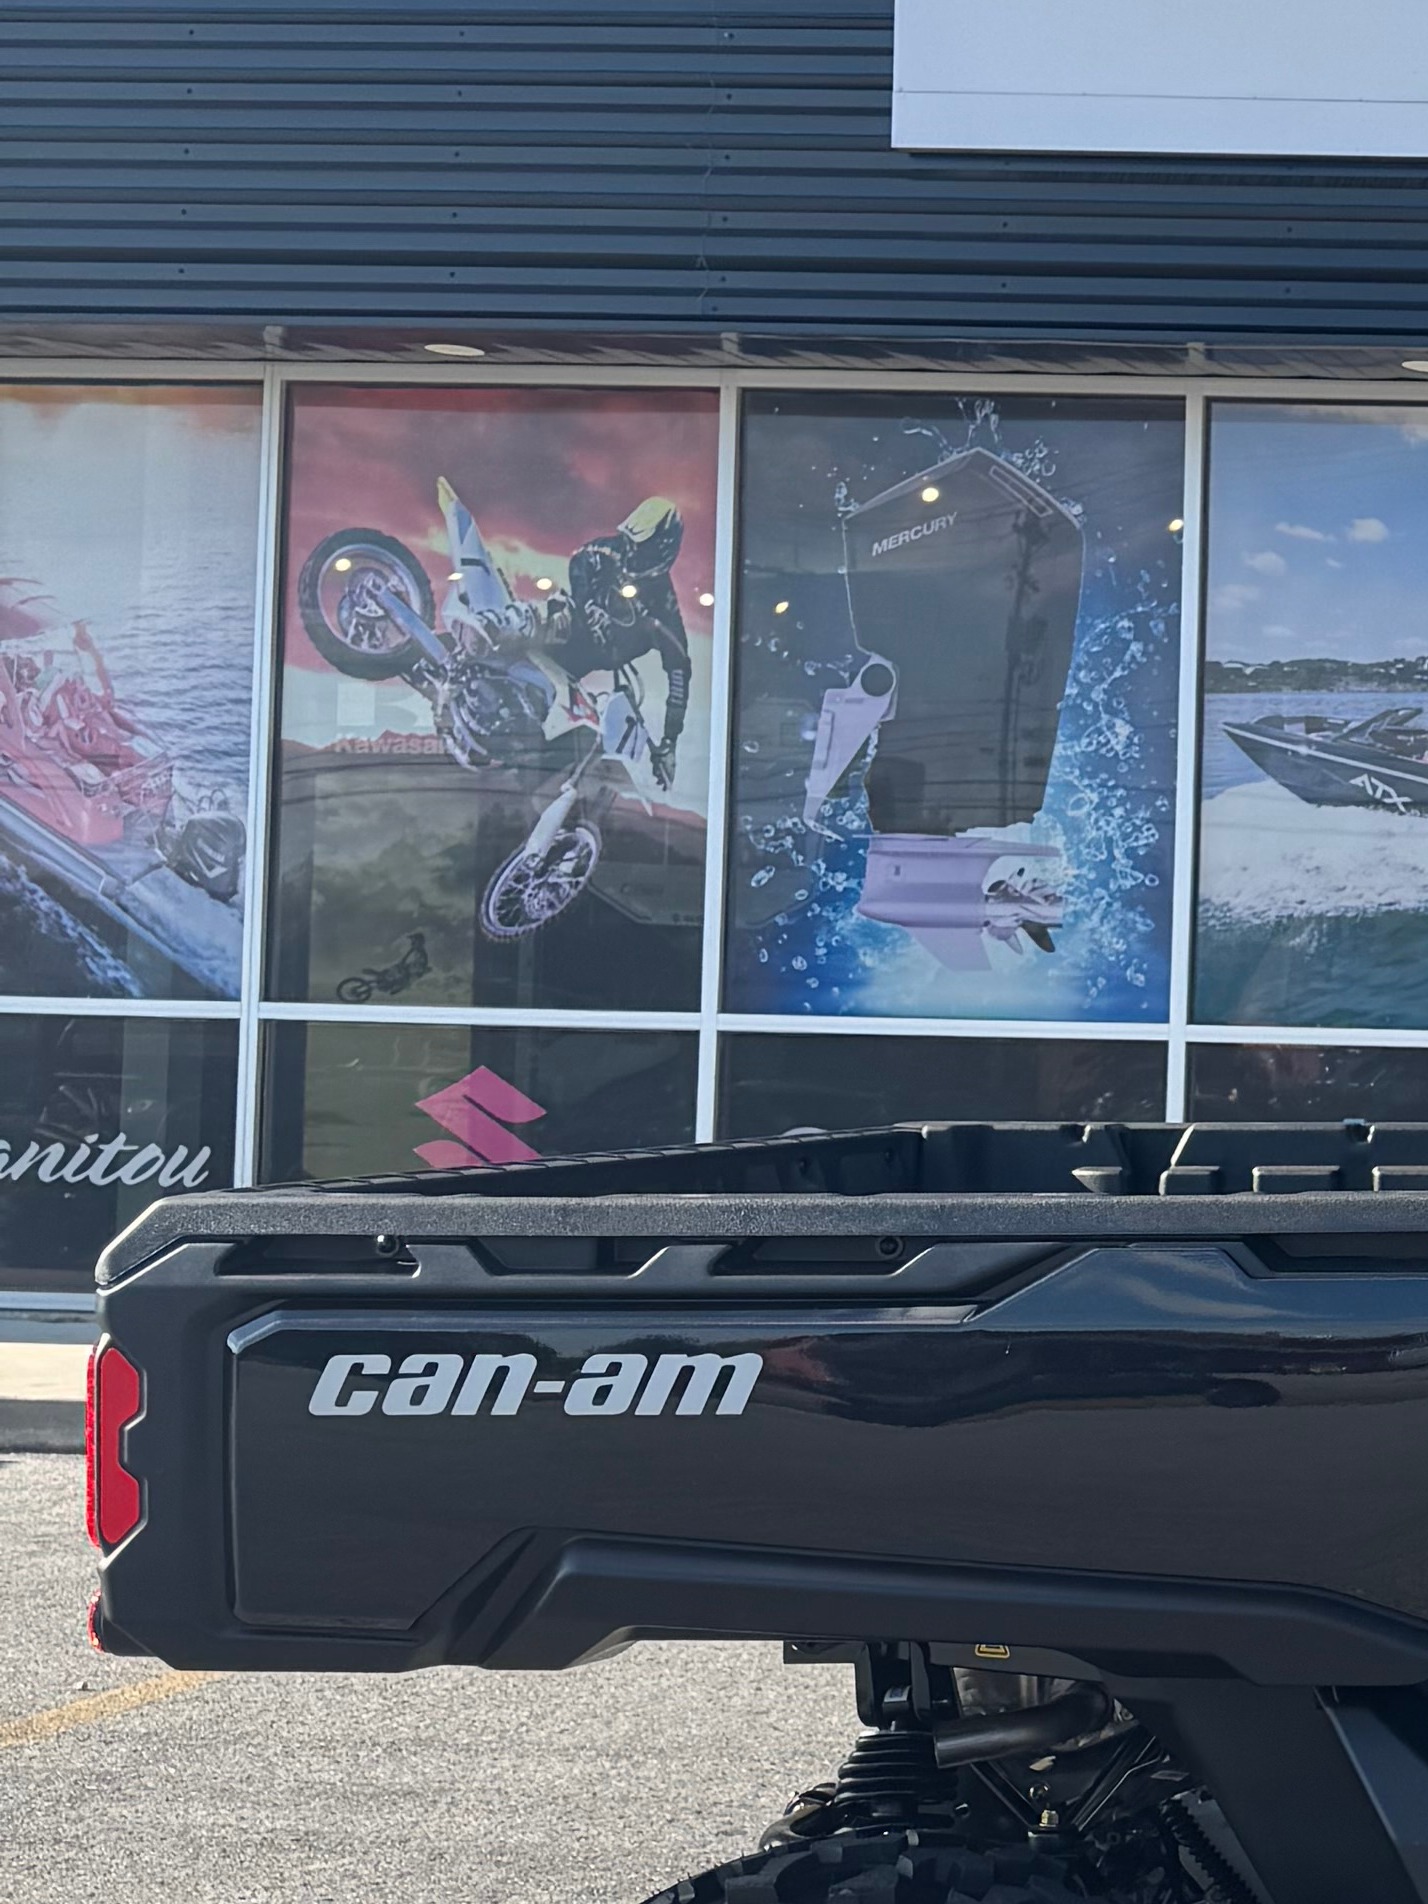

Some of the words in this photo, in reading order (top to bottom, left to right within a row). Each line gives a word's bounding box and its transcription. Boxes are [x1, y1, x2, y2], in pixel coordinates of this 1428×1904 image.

[872, 511, 957, 557] MERCURY
[335, 733, 450, 755] Kawasa
[1349, 773, 1414, 813] ATX
[0, 1132, 212, 1188] nitou
[308, 1353, 764, 1416] can-am
